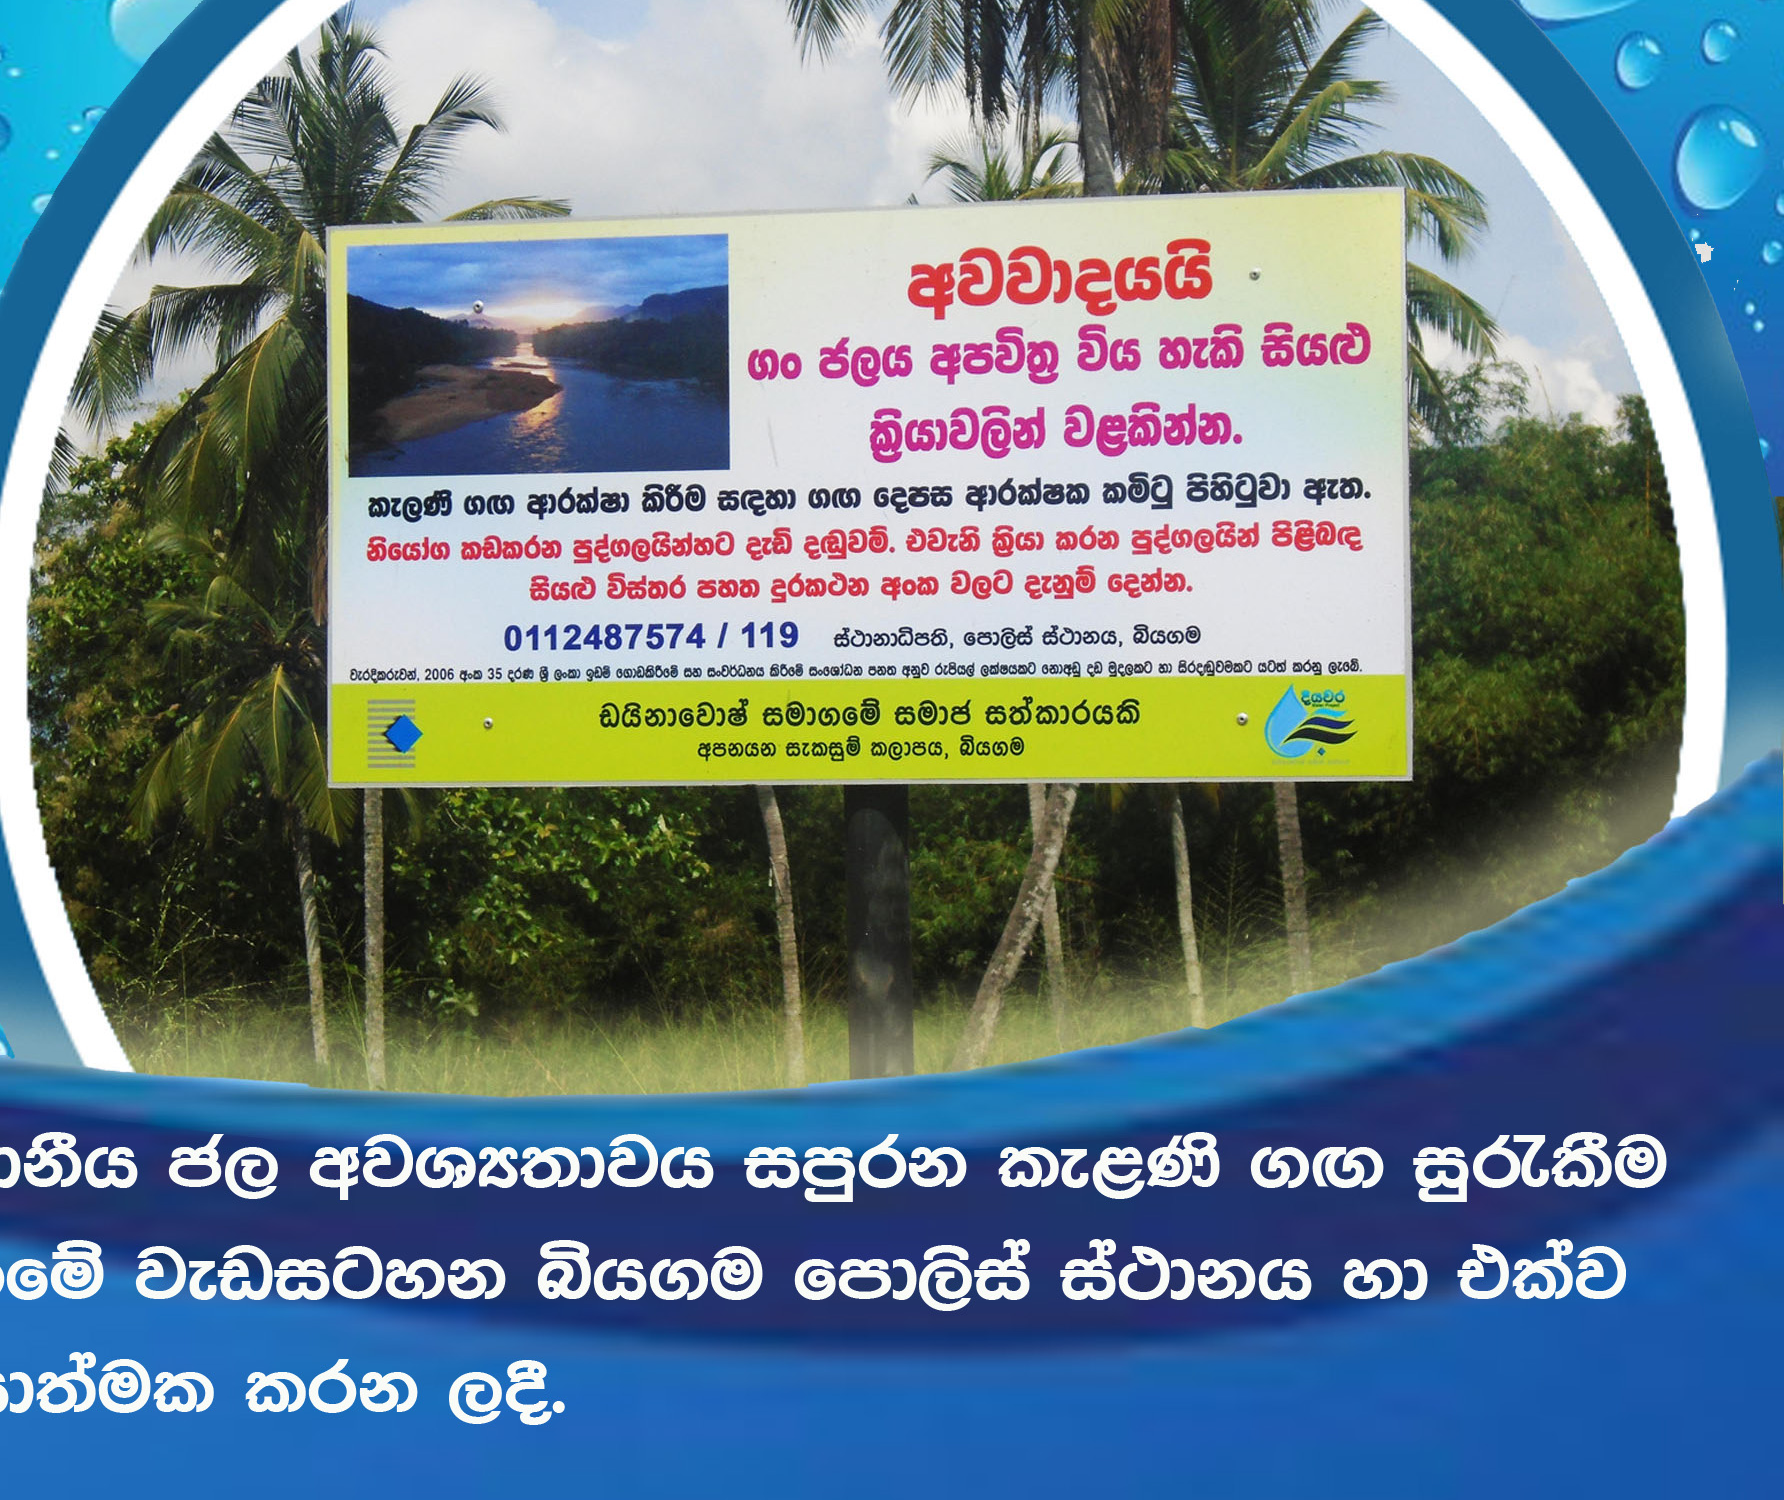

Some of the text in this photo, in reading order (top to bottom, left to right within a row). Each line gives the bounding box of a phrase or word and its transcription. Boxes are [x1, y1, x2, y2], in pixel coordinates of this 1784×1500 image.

[908, 239, 1212, 320] අවවාදයයි
[748, 322, 1370, 387] ගං ජලය අපවිත්‍ර විය හැකි සියළු
[870, 402, 1242, 463] ක්‍රියාවලින් වළකින්න.
[368, 472, 1371, 523] කැලණි ගඟ ආරක්ෂා කිරීම සඳහා ගඟ දෙපස ආරක්ෂක කමිටු පිහිටුවා ඇත.
[367, 520, 1363, 563] නියෝග කඩකරන පුද්ගලයින්හට දැඩි දඬුවම්. එවැනි ක්‍රියා කරන පුද්ගලයින් පිළිබඳ
[530, 565, 1192, 603] සියළු විස්තර පහත දුරකථන අංක වලට දැනුම් දෙන්න.
[504, 623, 706, 651] 0112487574
[742, 622, 798, 648] 119
[834, 627, 953, 648] ස්ථානාධිපති,
[964, 625, 1033, 649] පොලිස්
[1042, 625, 1122, 647] ස්ථානය,
[1133, 624, 1201, 644] බියගම
[425, 668, 454, 680] 2006
[488, 668, 502, 680] 35
[600, 696, 1140, 727] ඩයිනාවොෂ් සමාගමේ සමාජ සත්කාරයකි
[698, 735, 1024, 761] අපනයන සැකසුම් කලාපය, බියගම
